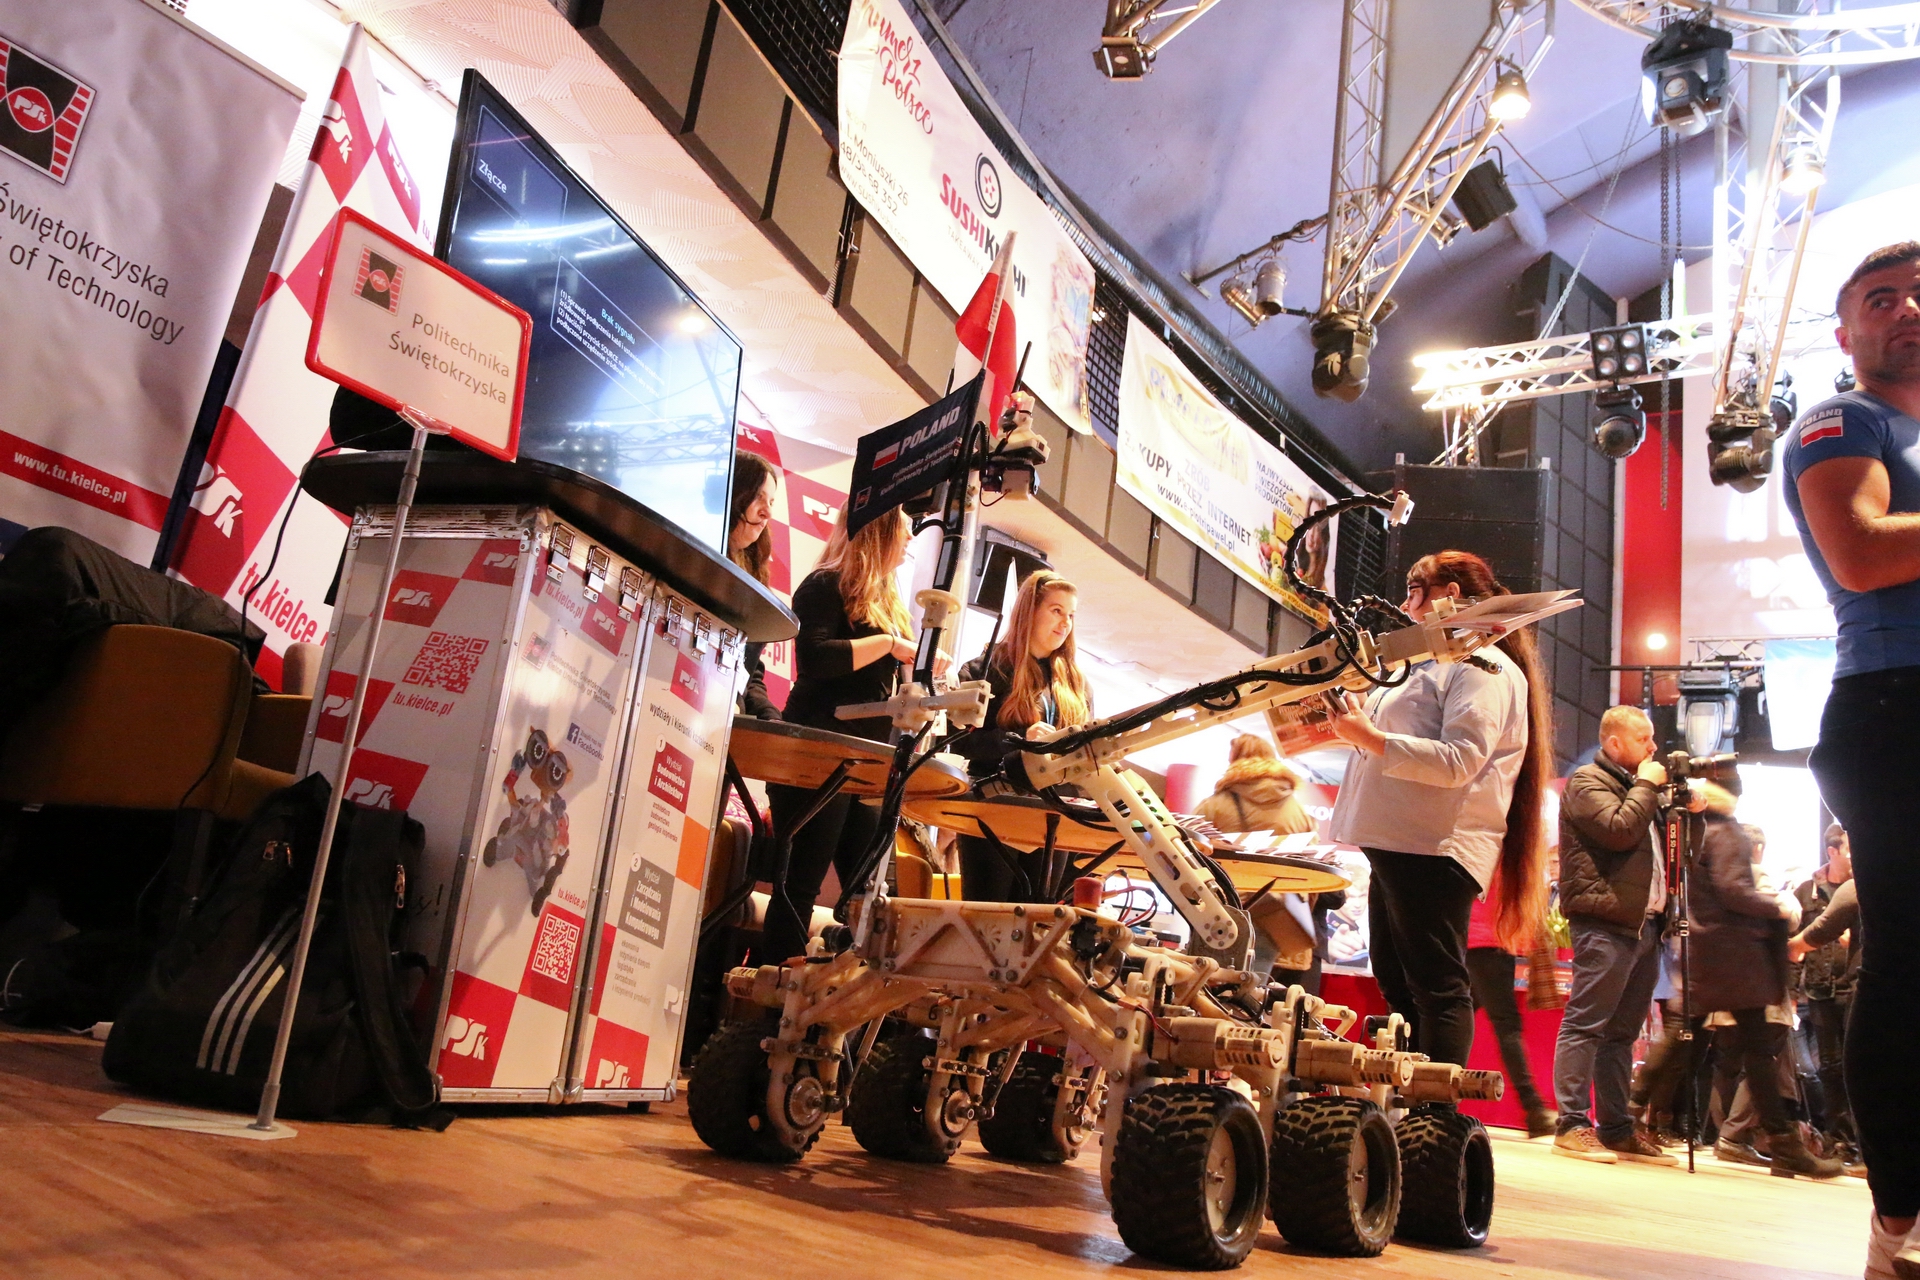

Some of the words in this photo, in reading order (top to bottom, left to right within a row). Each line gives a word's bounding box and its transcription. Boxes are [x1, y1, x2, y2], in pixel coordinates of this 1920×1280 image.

[478, 158, 507, 193] Złącze
[897, 184, 909, 206] 26
[882, 188, 898, 216] 352
[939, 173, 1026, 298] SUSHIKHI
[9, 244, 38, 271] of
[47, 254, 184, 345] Technology
[389, 330, 507, 404] Świętokrzyska
[412, 313, 510, 378] Politechnika
[900, 406, 960, 456] POLAND
[1800, 408, 1843, 429] POLAND
[14, 452, 127, 504] www.tu.kielce.pl
[1124, 430, 1173, 479] ZKUPY
[1207, 500, 1252, 547] INTERNET
[393, 691, 455, 717] tu.kielce.pl
[557, 887, 588, 910] tu.kielce.pl
